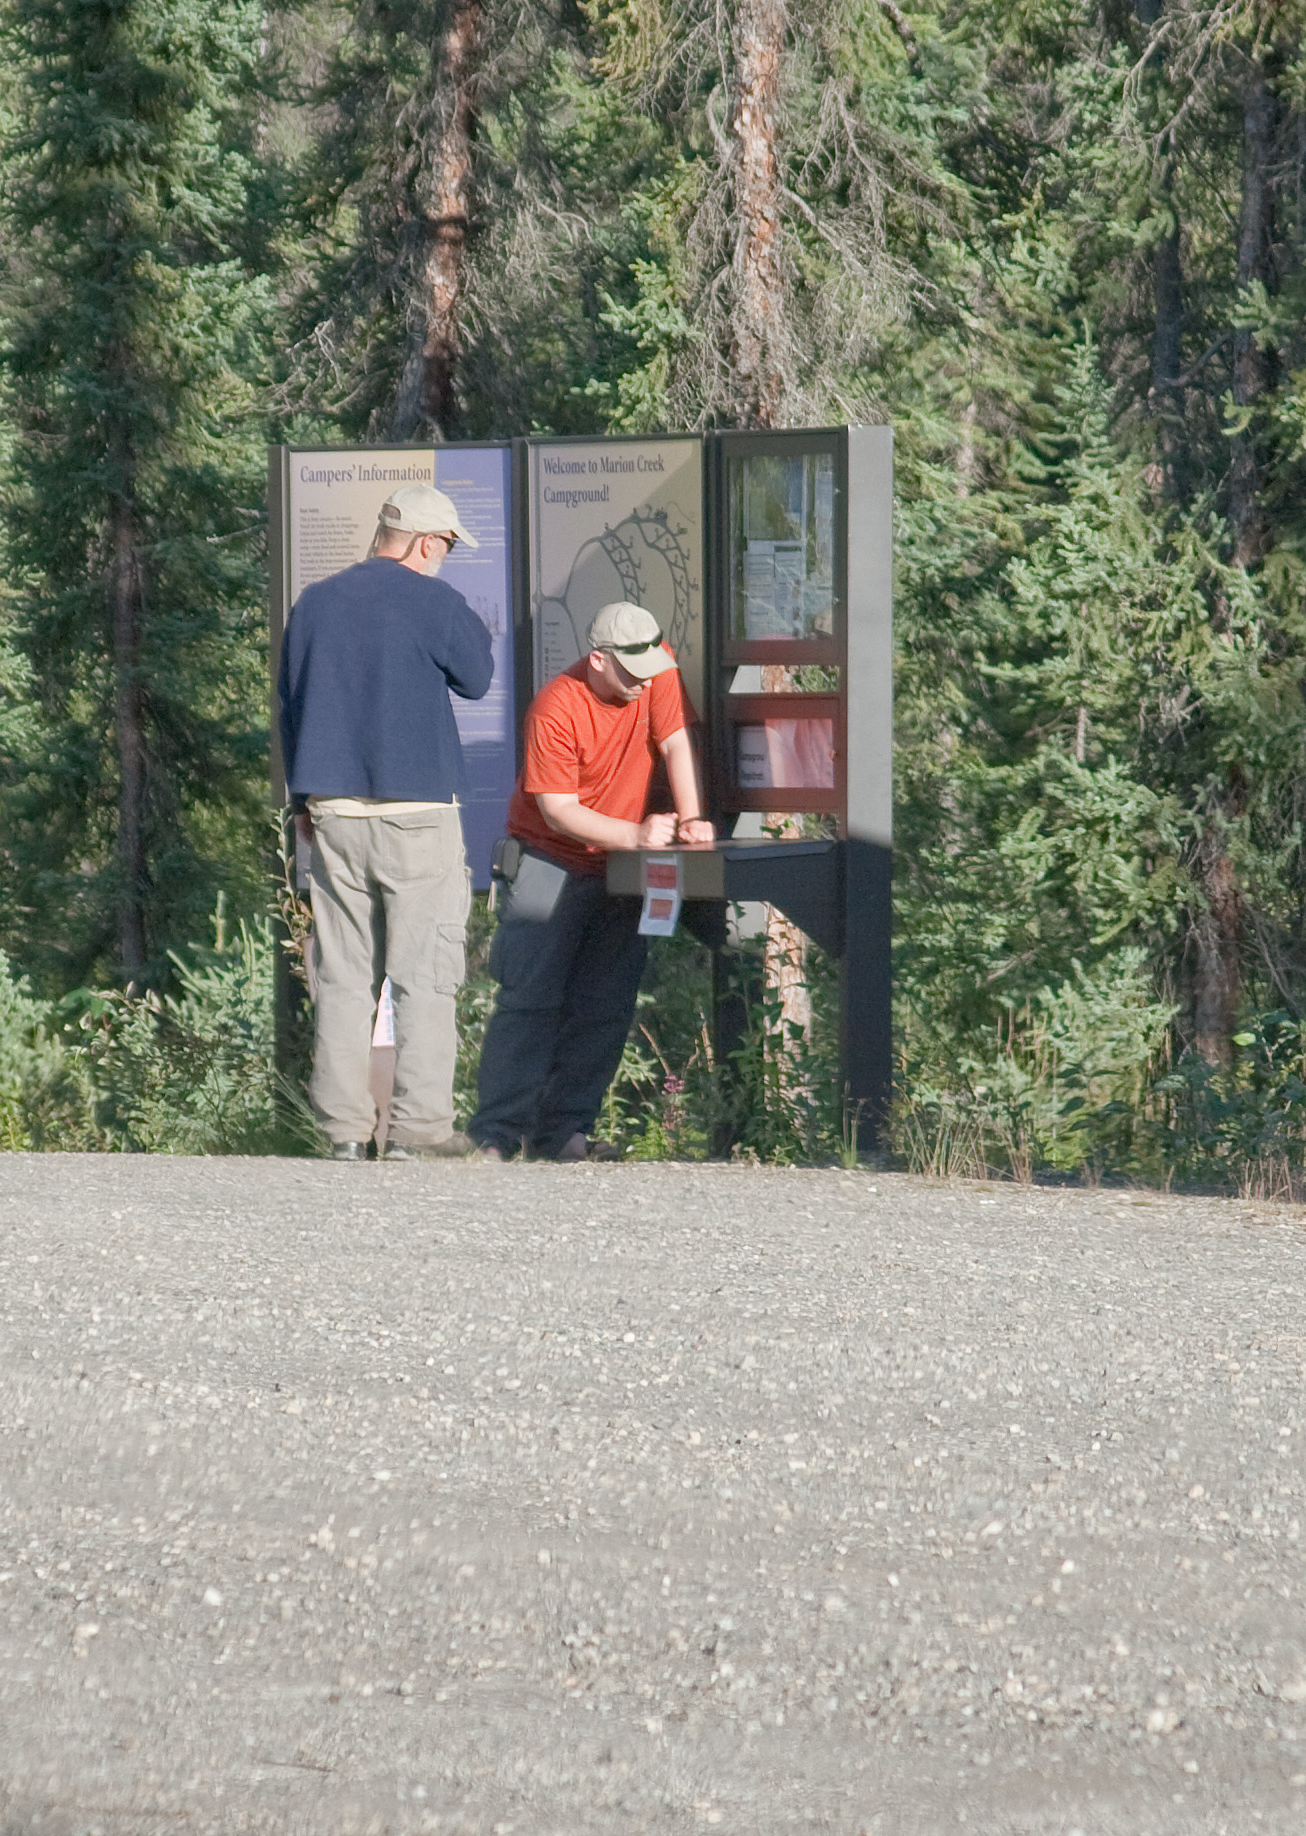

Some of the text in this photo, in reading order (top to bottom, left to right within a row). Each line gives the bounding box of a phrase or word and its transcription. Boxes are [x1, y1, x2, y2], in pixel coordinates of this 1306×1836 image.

[358, 463, 432, 481] Information
[543, 453, 665, 474] Welcome to Marion Creek
[543, 484, 610, 508] Campground!
